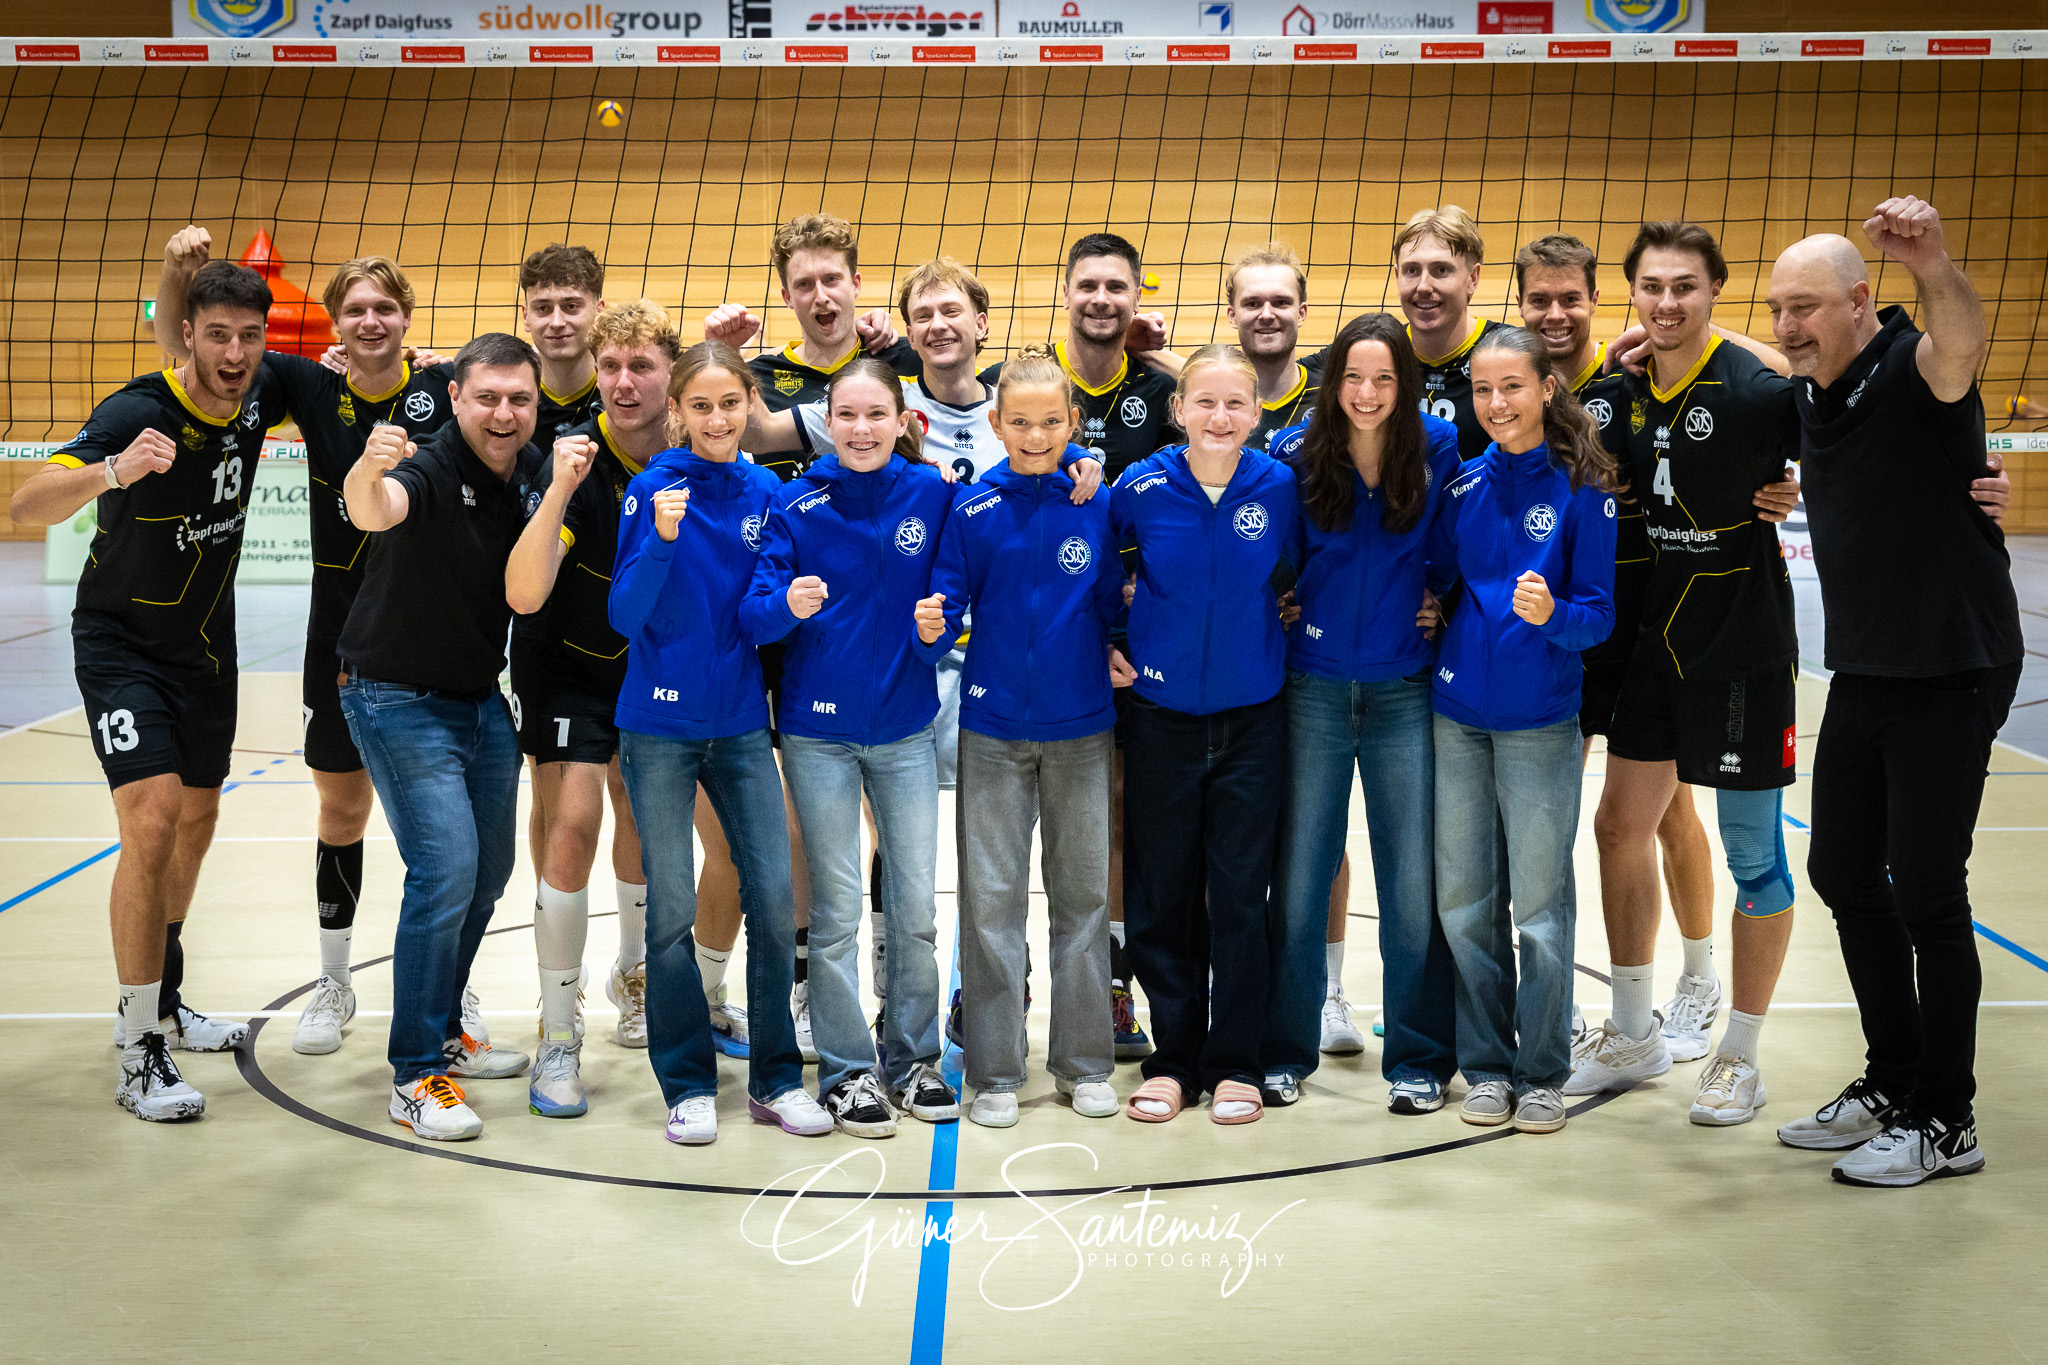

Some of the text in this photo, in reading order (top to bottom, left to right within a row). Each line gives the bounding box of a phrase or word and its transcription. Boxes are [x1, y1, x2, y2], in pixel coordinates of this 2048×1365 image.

[331, 13, 452, 32] Zapf Daigfuss
[806, 5, 984, 37] schweiger
[1502, 14, 1544, 25] Sparkasse
[1282, 438, 1306, 456] Kem
[1986, 438, 2012, 450] HS
[212, 456, 242, 504] 13
[1134, 476, 1168, 494] Kempa
[1452, 476, 1481, 498] Kempa
[1652, 458, 1674, 506] 4
[964, 495, 1002, 518] Kempa
[187, 524, 213, 542] Zapf
[1662, 528, 1718, 542] Daigfuss
[1306, 624, 1324, 640] MF
[1143, 665, 1165, 682] NA
[1438, 667, 1454, 684] AM
[652, 687, 679, 702] KB
[968, 684, 988, 699] IW
[812, 700, 836, 715] MR
[98, 708, 140, 755] 13
